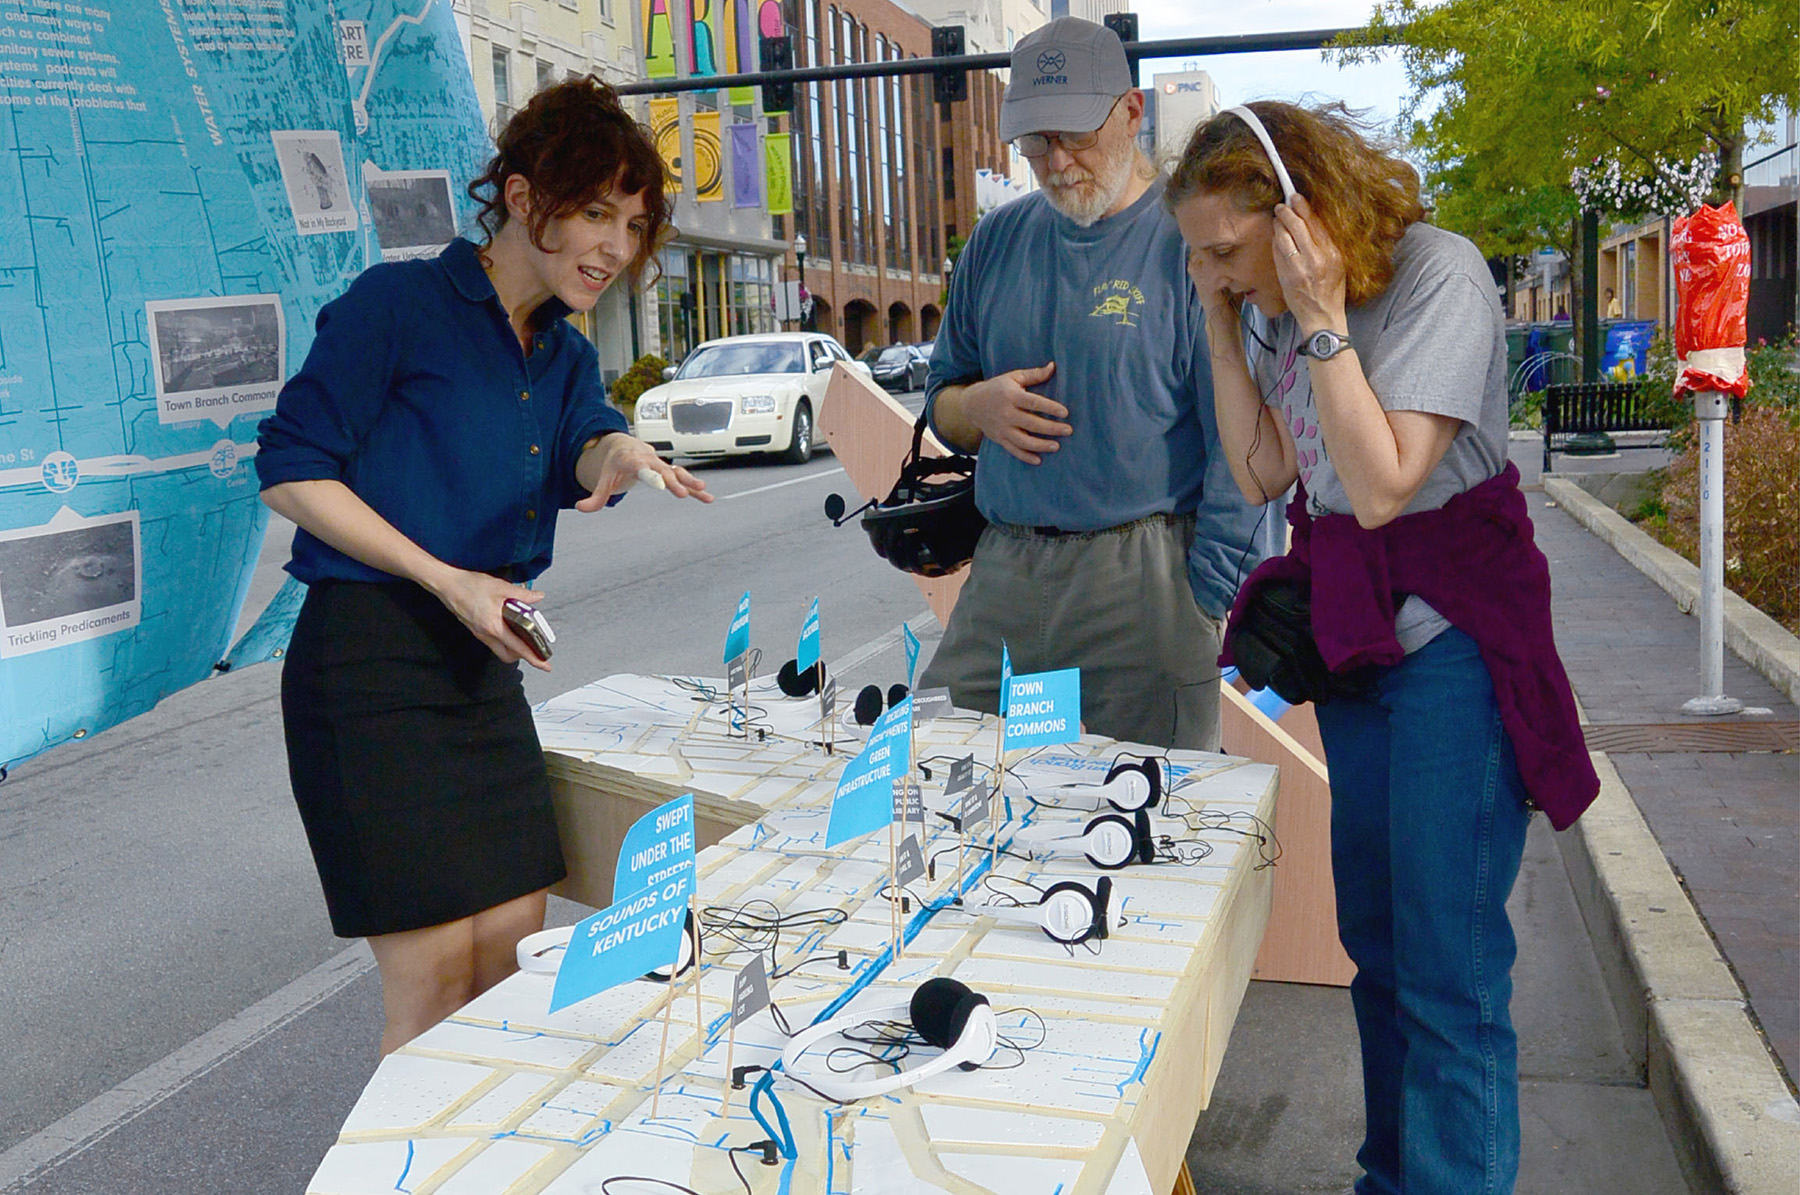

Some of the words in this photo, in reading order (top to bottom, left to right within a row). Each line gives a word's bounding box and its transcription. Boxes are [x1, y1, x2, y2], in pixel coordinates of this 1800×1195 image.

[5, 10, 28, 23] and
[31, 14, 61, 28] many
[64, 18, 91, 32] ways
[93, 22, 104, 32] to
[65, 3, 82, 14] are
[84, 6, 111, 21] many
[19, 29, 33, 39] as
[36, 30, 90, 45] combined
[161, 0, 198, 78] SYSTEMS
[41, 47, 75, 60] sewer
[343, 45, 364, 60] RE
[46, 62, 97, 77] podcasts
[98, 67, 117, 78] will
[0, 75, 32, 88] cities
[35, 79, 84, 94] currently
[87, 81, 113, 93] deal
[114, 83, 136, 95] with
[1032, 75, 1068, 87] WERNER
[1178, 81, 1202, 93] PNC
[35, 94, 48, 106] of
[50, 95, 69, 106] the
[72, 96, 125, 110] problems
[125, 100, 147, 112] that
[193, 84, 224, 147] WATER
[299, 219, 310, 229] Not
[316, 217, 325, 230] My
[325, 216, 346, 228] Backyard
[164, 400, 192, 412] Town
[195, 394, 229, 409] Branch
[232, 389, 276, 404] Commons
[20, 448, 34, 461] St
[7, 627, 57, 648] Trickling
[60, 609, 131, 636] Predicaments
[1010, 681, 1044, 697] TOWN
[912, 694, 947, 704] OROUGHBRED
[1008, 700, 1054, 718] BRANCH
[1007, 718, 1067, 738] COMMONS
[869, 744, 891, 765] GREEN
[836, 764, 892, 801] INFRASTRUCTURE
[656, 804, 690, 834] SWEPT
[631, 842, 668, 872] UNDER
[670, 832, 692, 855] THE
[587, 891, 659, 938] SOUNDS
[662, 878, 688, 901] OF
[591, 905, 684, 958] KENTUCKY
